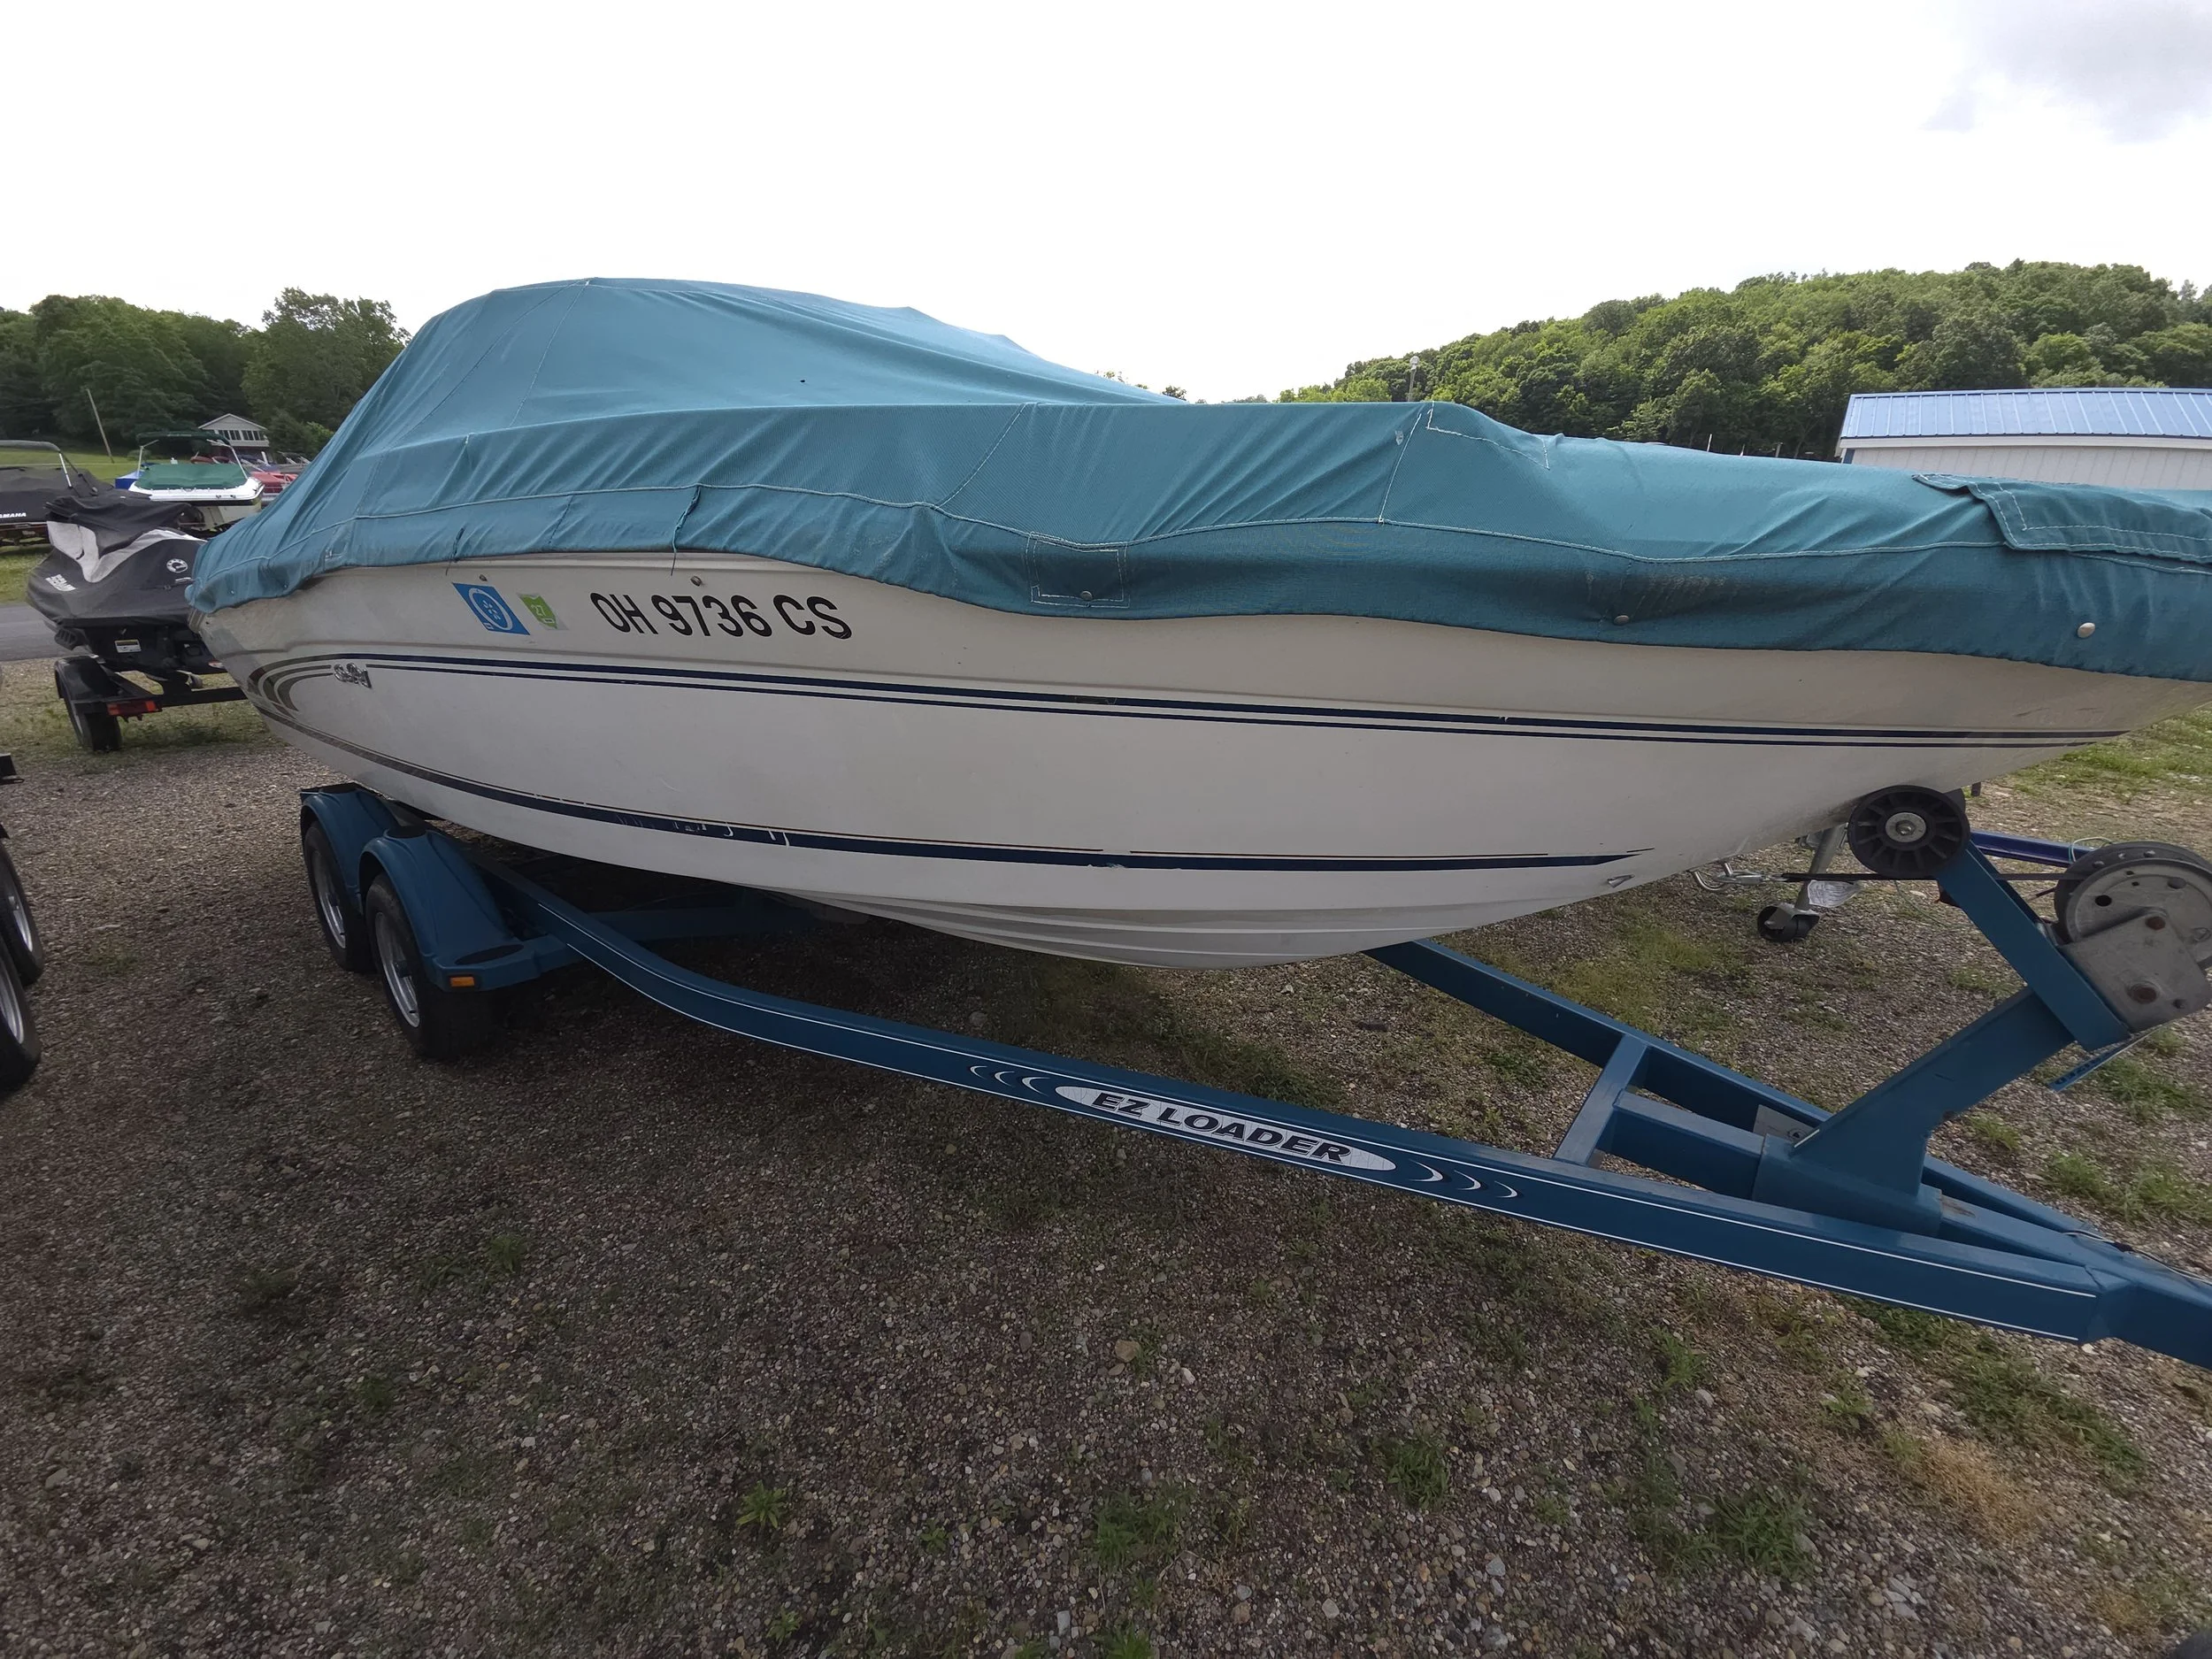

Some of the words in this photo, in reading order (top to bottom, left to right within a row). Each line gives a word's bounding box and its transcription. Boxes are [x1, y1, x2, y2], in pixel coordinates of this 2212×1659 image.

[590, 592, 658, 634] OH
[650, 595, 772, 637] 9736
[772, 595, 852, 640] CS
[1091, 1092, 1150, 1118] EZ
[1156, 1107, 1351, 1164] LOADER
